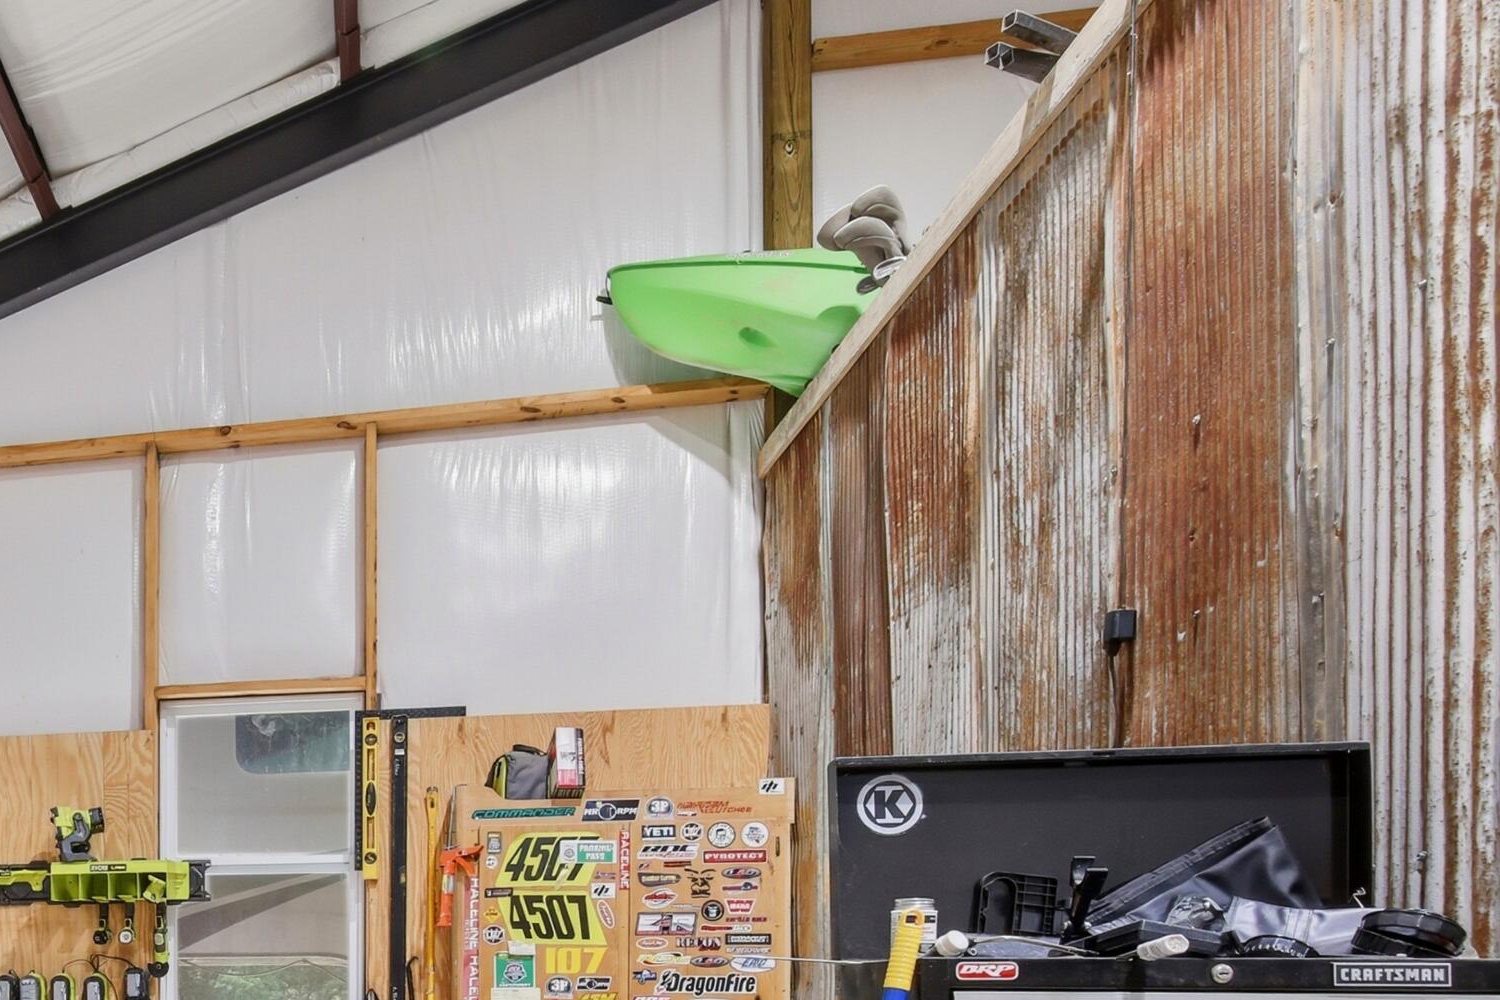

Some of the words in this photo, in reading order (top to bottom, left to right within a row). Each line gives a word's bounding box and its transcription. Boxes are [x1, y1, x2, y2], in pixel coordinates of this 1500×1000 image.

[643, 827, 674, 837] YETI
[510, 895, 590, 940] 4507
[545, 947, 608, 974] 107
[1339, 967, 1445, 983] CRAFTSMAN
